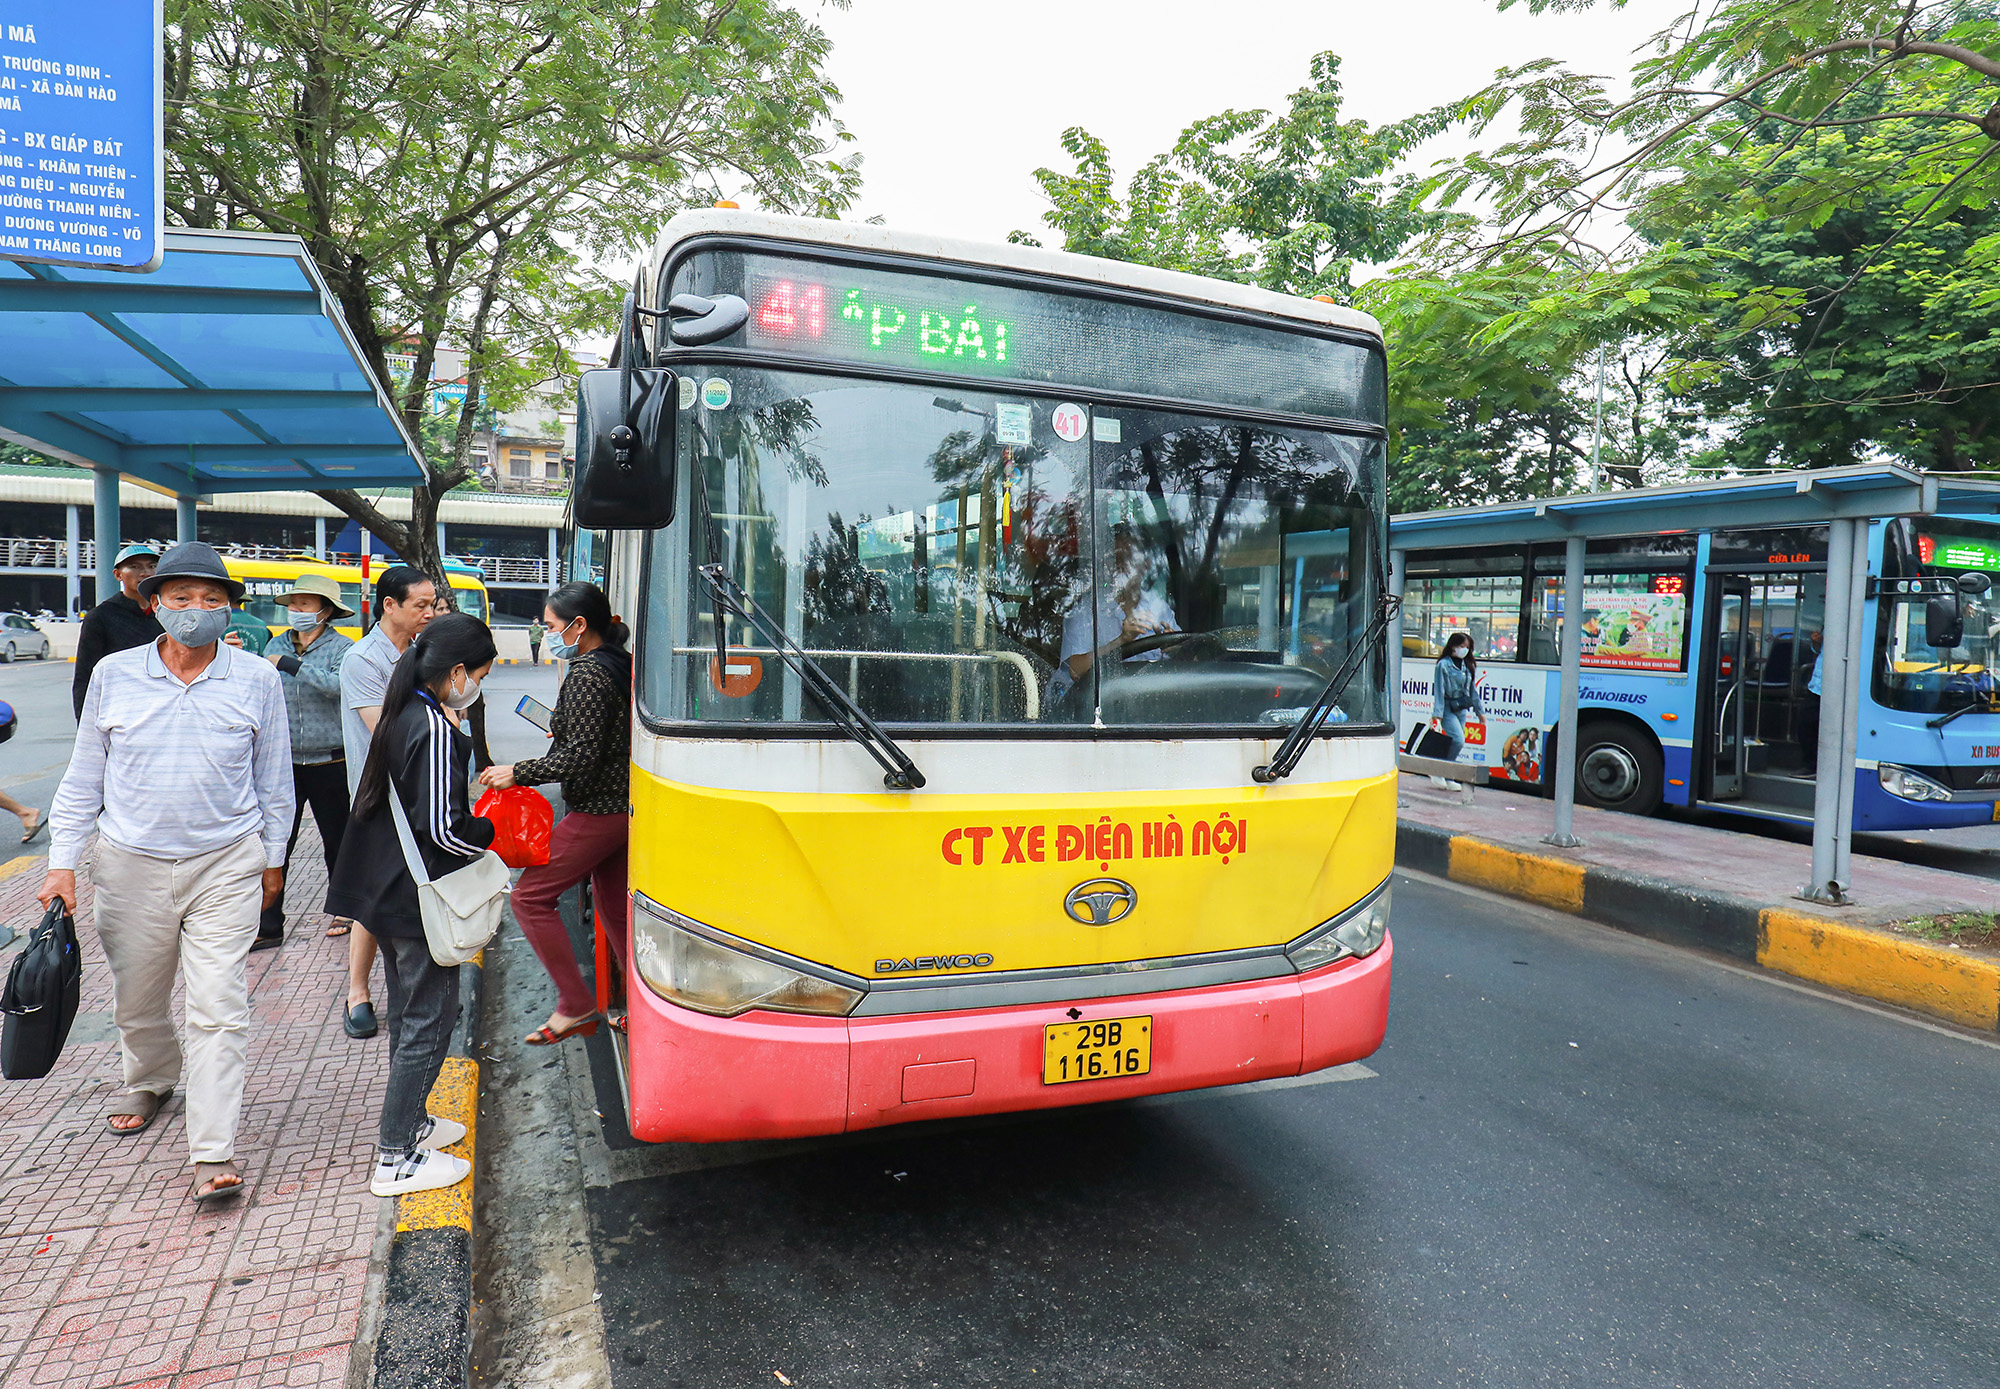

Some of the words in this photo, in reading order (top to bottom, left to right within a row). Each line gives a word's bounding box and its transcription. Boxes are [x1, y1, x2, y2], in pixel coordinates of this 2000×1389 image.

[8, 24, 36, 44] MÃ
[2, 55, 61, 75] TRƯƠNG
[65, 63, 100, 80] ĐỊNH
[32, 78, 50, 95] XÃ
[54, 80, 83, 98] ĐÀN
[88, 85, 117, 102] HÀO
[24, 131, 46, 149] BX
[50, 132, 88, 153] GIÁP
[93, 137, 124, 157] BÁT
[39, 158, 81, 175] KHÂM
[84, 164, 126, 180] THIÊN
[20, 176, 54, 193] DIỆU
[69, 182, 125, 200] NGUYỄN
[47, 199, 95, 216] THANH
[99, 204, 132, 220] NIÊN
[5, 216, 55, 232] DƯƠNG
[59, 221, 108, 238] VƯƠNG
[122, 226, 142, 241] VÕ
[33, 238, 81, 254] THĂNG
[85, 243, 122, 258] LONG
[760, 280, 824, 338] 41
[1055, 412, 1080, 437] 41
[1790, 552, 1810, 563] LÊN
[1402, 677, 1428, 695] KÍNH
[1479, 683, 1498, 704] IỆT
[1501, 685, 1522, 704] TÍN
[1494, 708, 1513, 717] HỌC
[1515, 709, 1533, 719] MỚI
[941, 826, 994, 866] CT
[1001, 825, 1045, 864] XE
[1055, 815, 1133, 872] ĐIỆN
[1142, 813, 1183, 858] HÀ
[1191, 811, 1247, 866] NỘI
[875, 953, 994, 973] DAEWOO
[1076, 1022, 1122, 1050] 29B
[1059, 1048, 1140, 1080] 116.16
